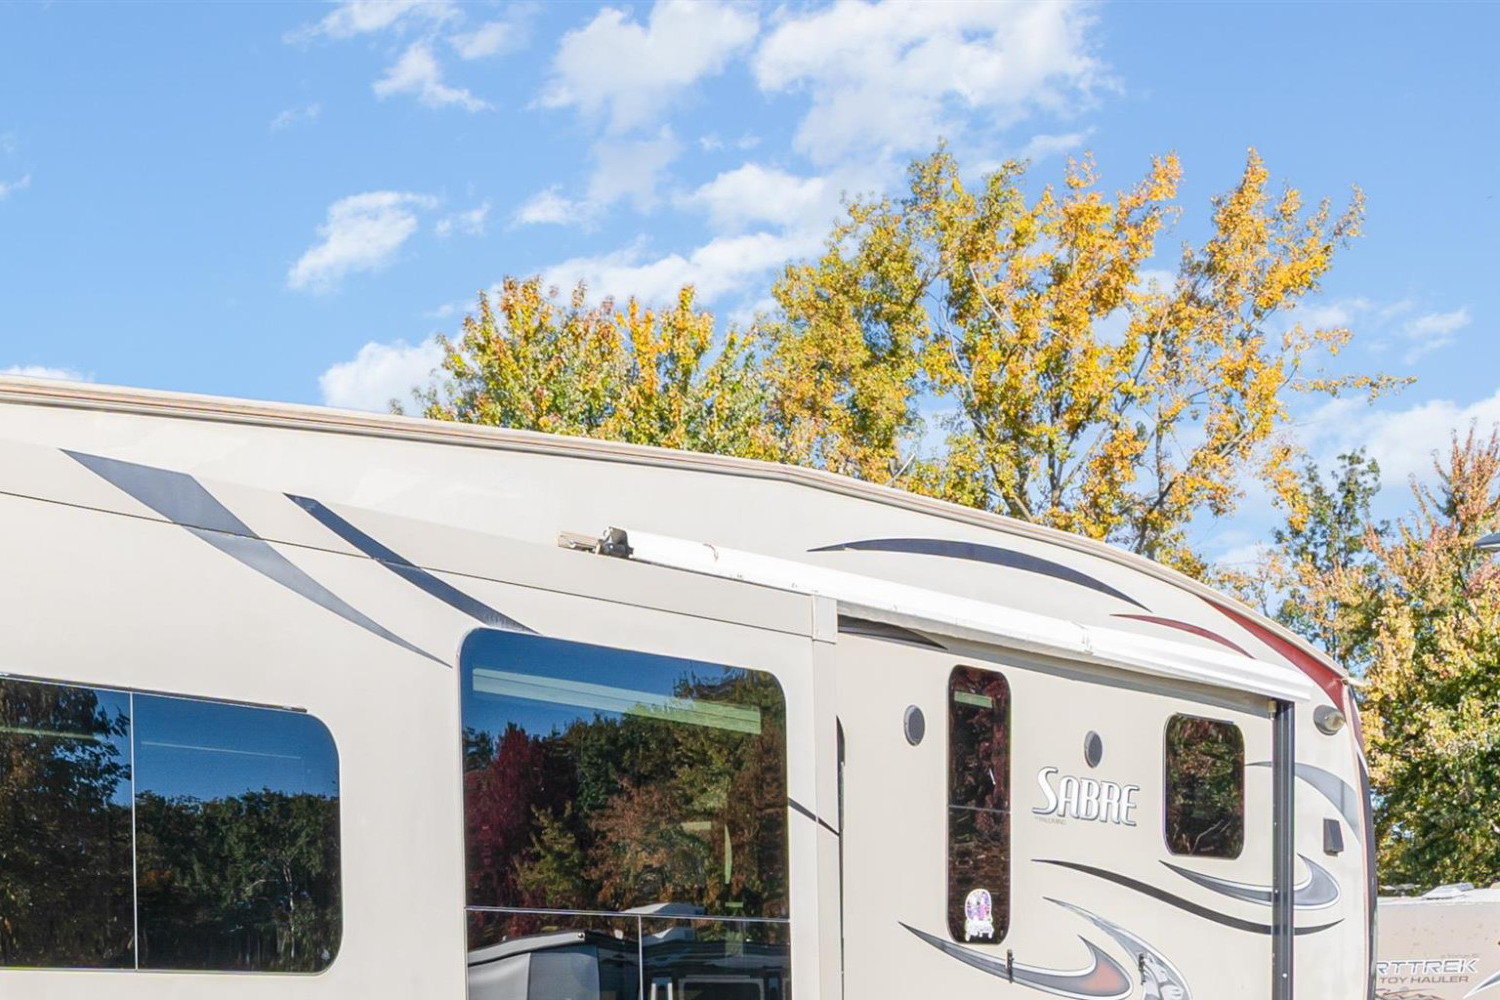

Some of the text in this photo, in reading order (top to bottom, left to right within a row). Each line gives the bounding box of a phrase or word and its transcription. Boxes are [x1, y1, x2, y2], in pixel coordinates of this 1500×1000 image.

[1032, 766, 1140, 826] SABRE
[1380, 975, 1469, 984] TOY HAULER
